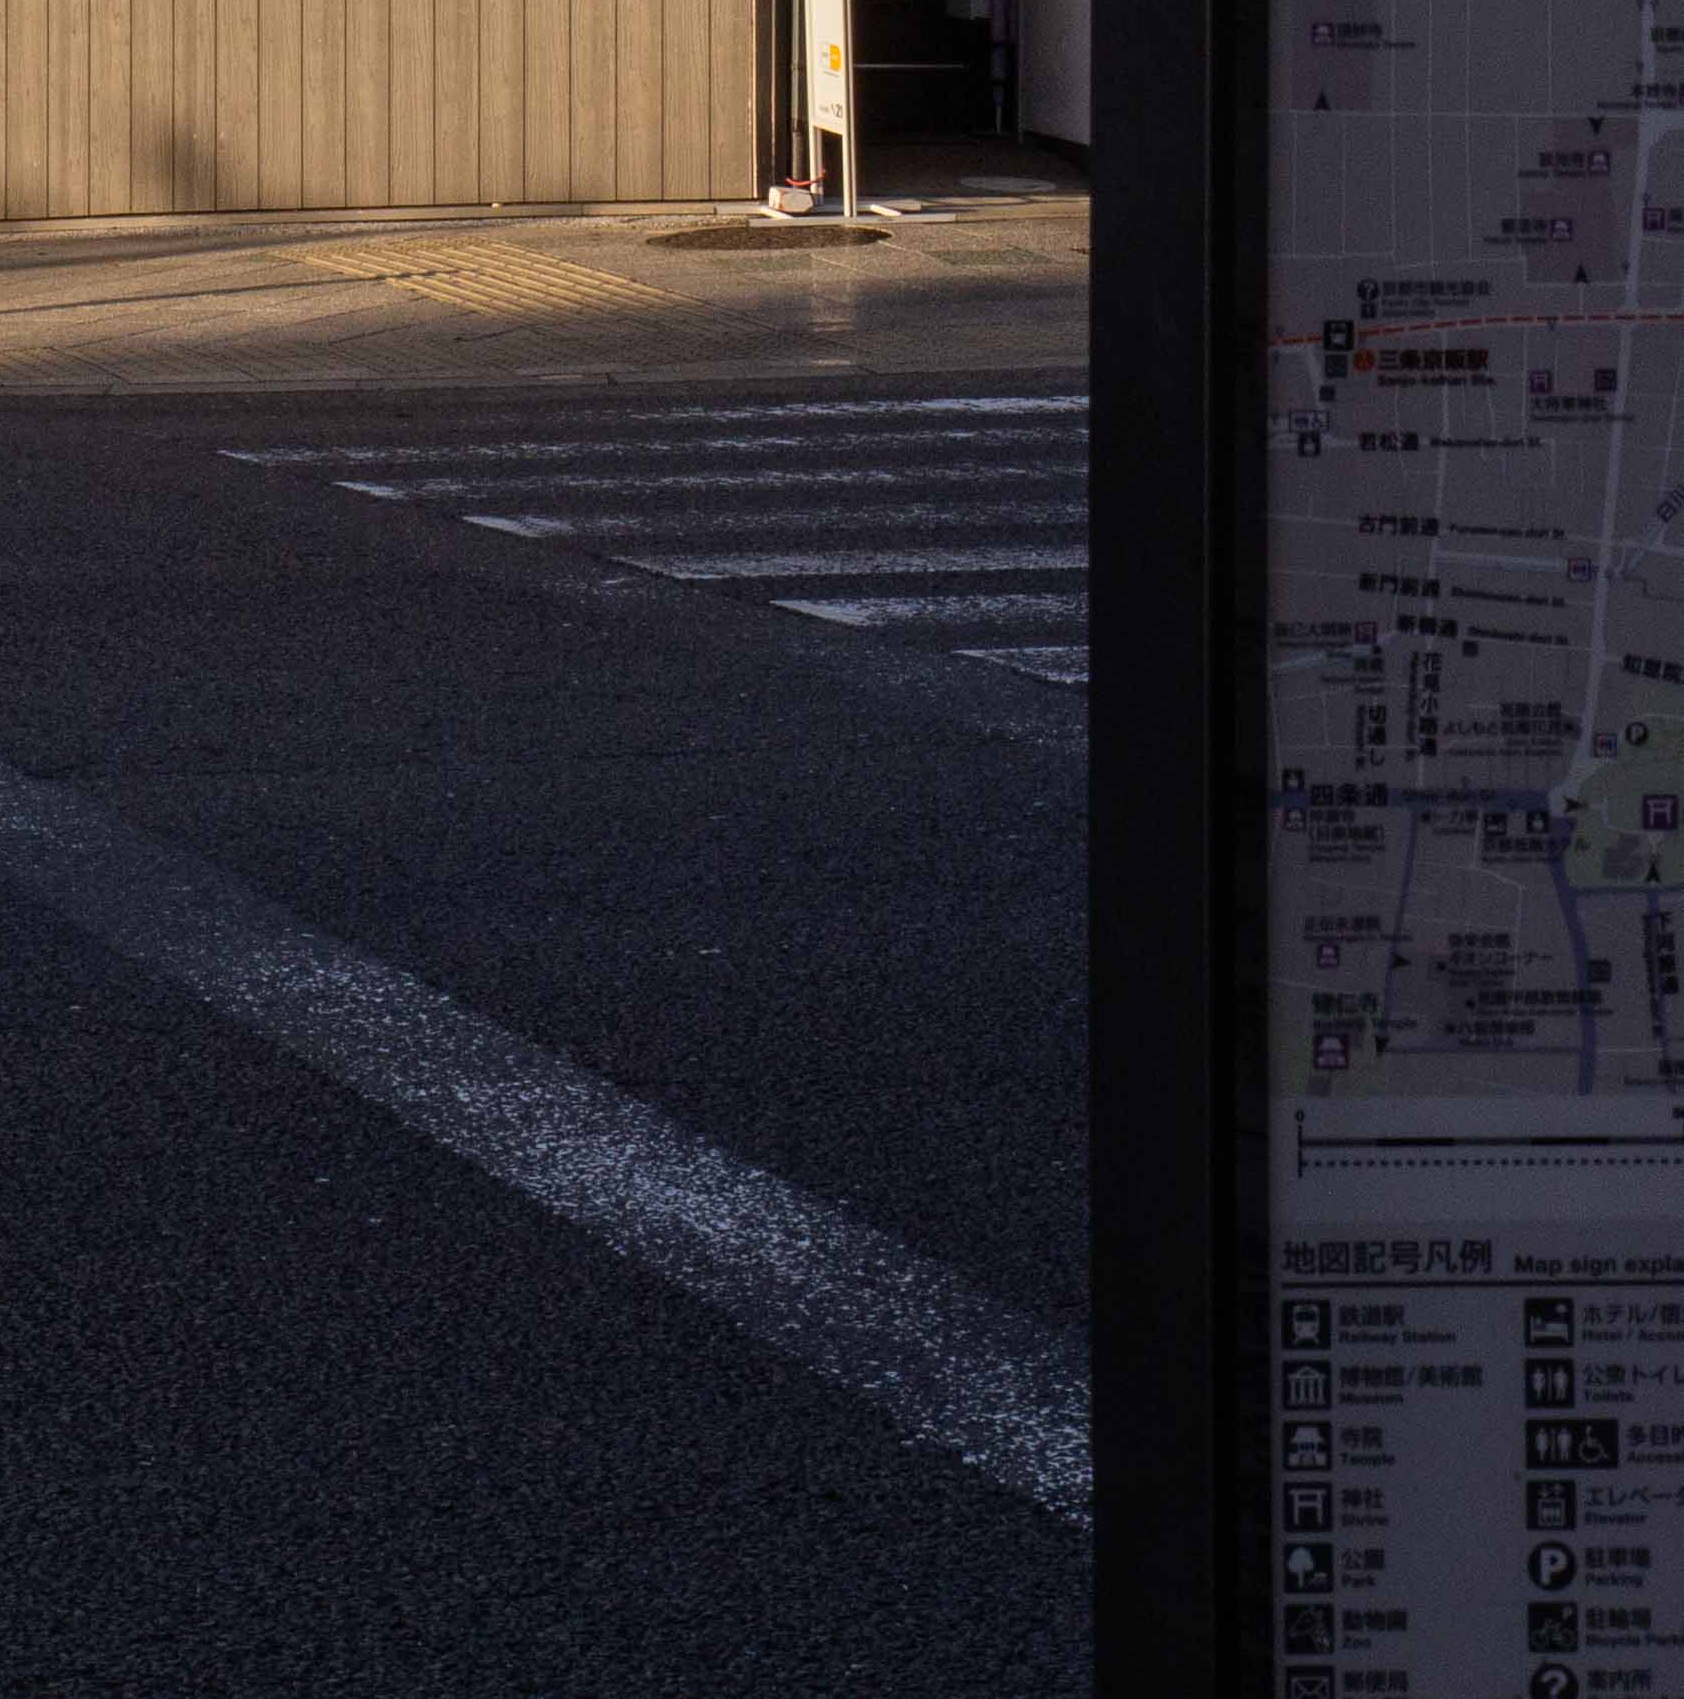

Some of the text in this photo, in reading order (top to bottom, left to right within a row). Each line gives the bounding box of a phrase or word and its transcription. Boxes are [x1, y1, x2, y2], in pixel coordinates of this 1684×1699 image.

[1282, 1238, 1493, 1275] 地図記号凡例
[1514, 1254, 1563, 1277] Map
[1570, 1254, 1617, 1277] sign
